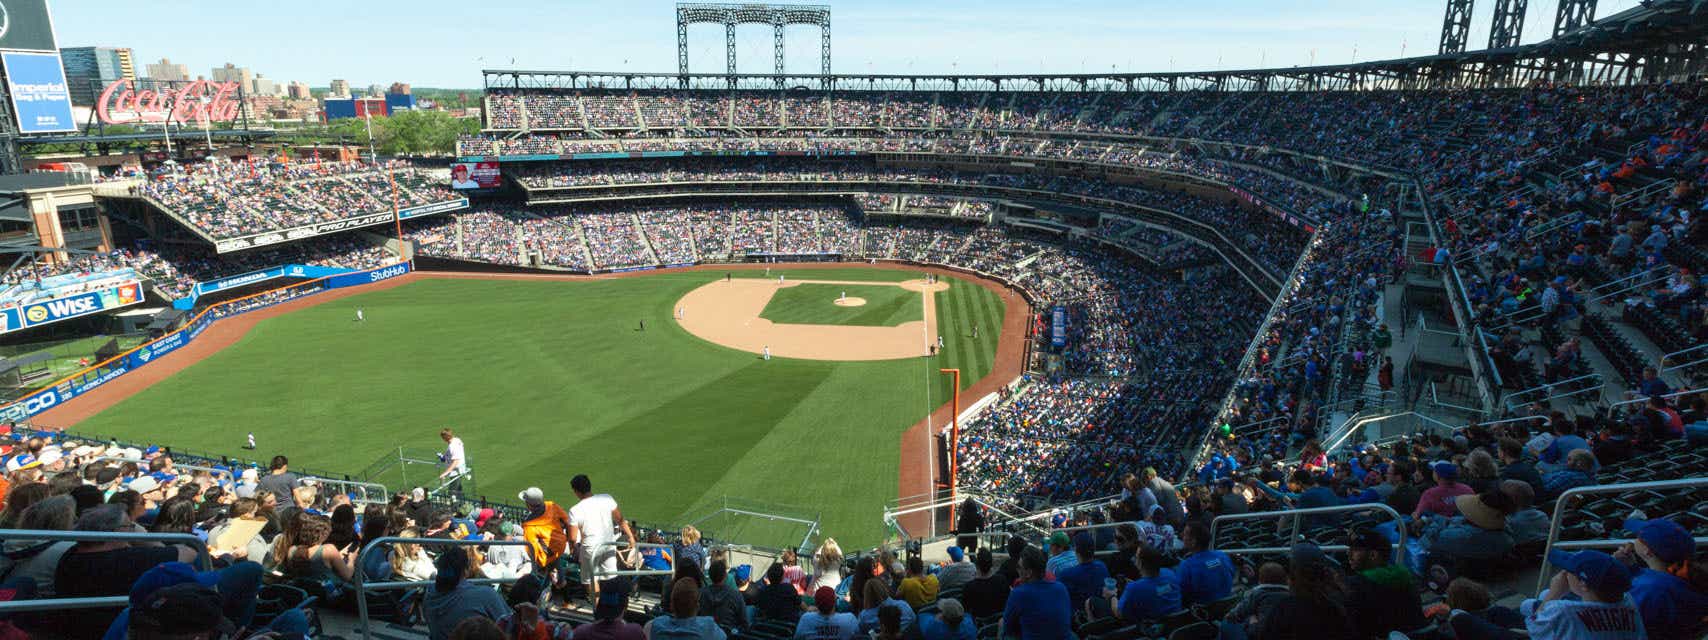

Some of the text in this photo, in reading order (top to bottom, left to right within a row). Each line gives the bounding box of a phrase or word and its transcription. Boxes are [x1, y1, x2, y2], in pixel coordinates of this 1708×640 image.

[318, 221, 344, 233] PRO
[344, 214, 392, 228] PLAYER
[370, 265, 405, 281] StubHub
[47, 296, 98, 317] WISE
[1576, 607, 1637, 632] WRIGHT
